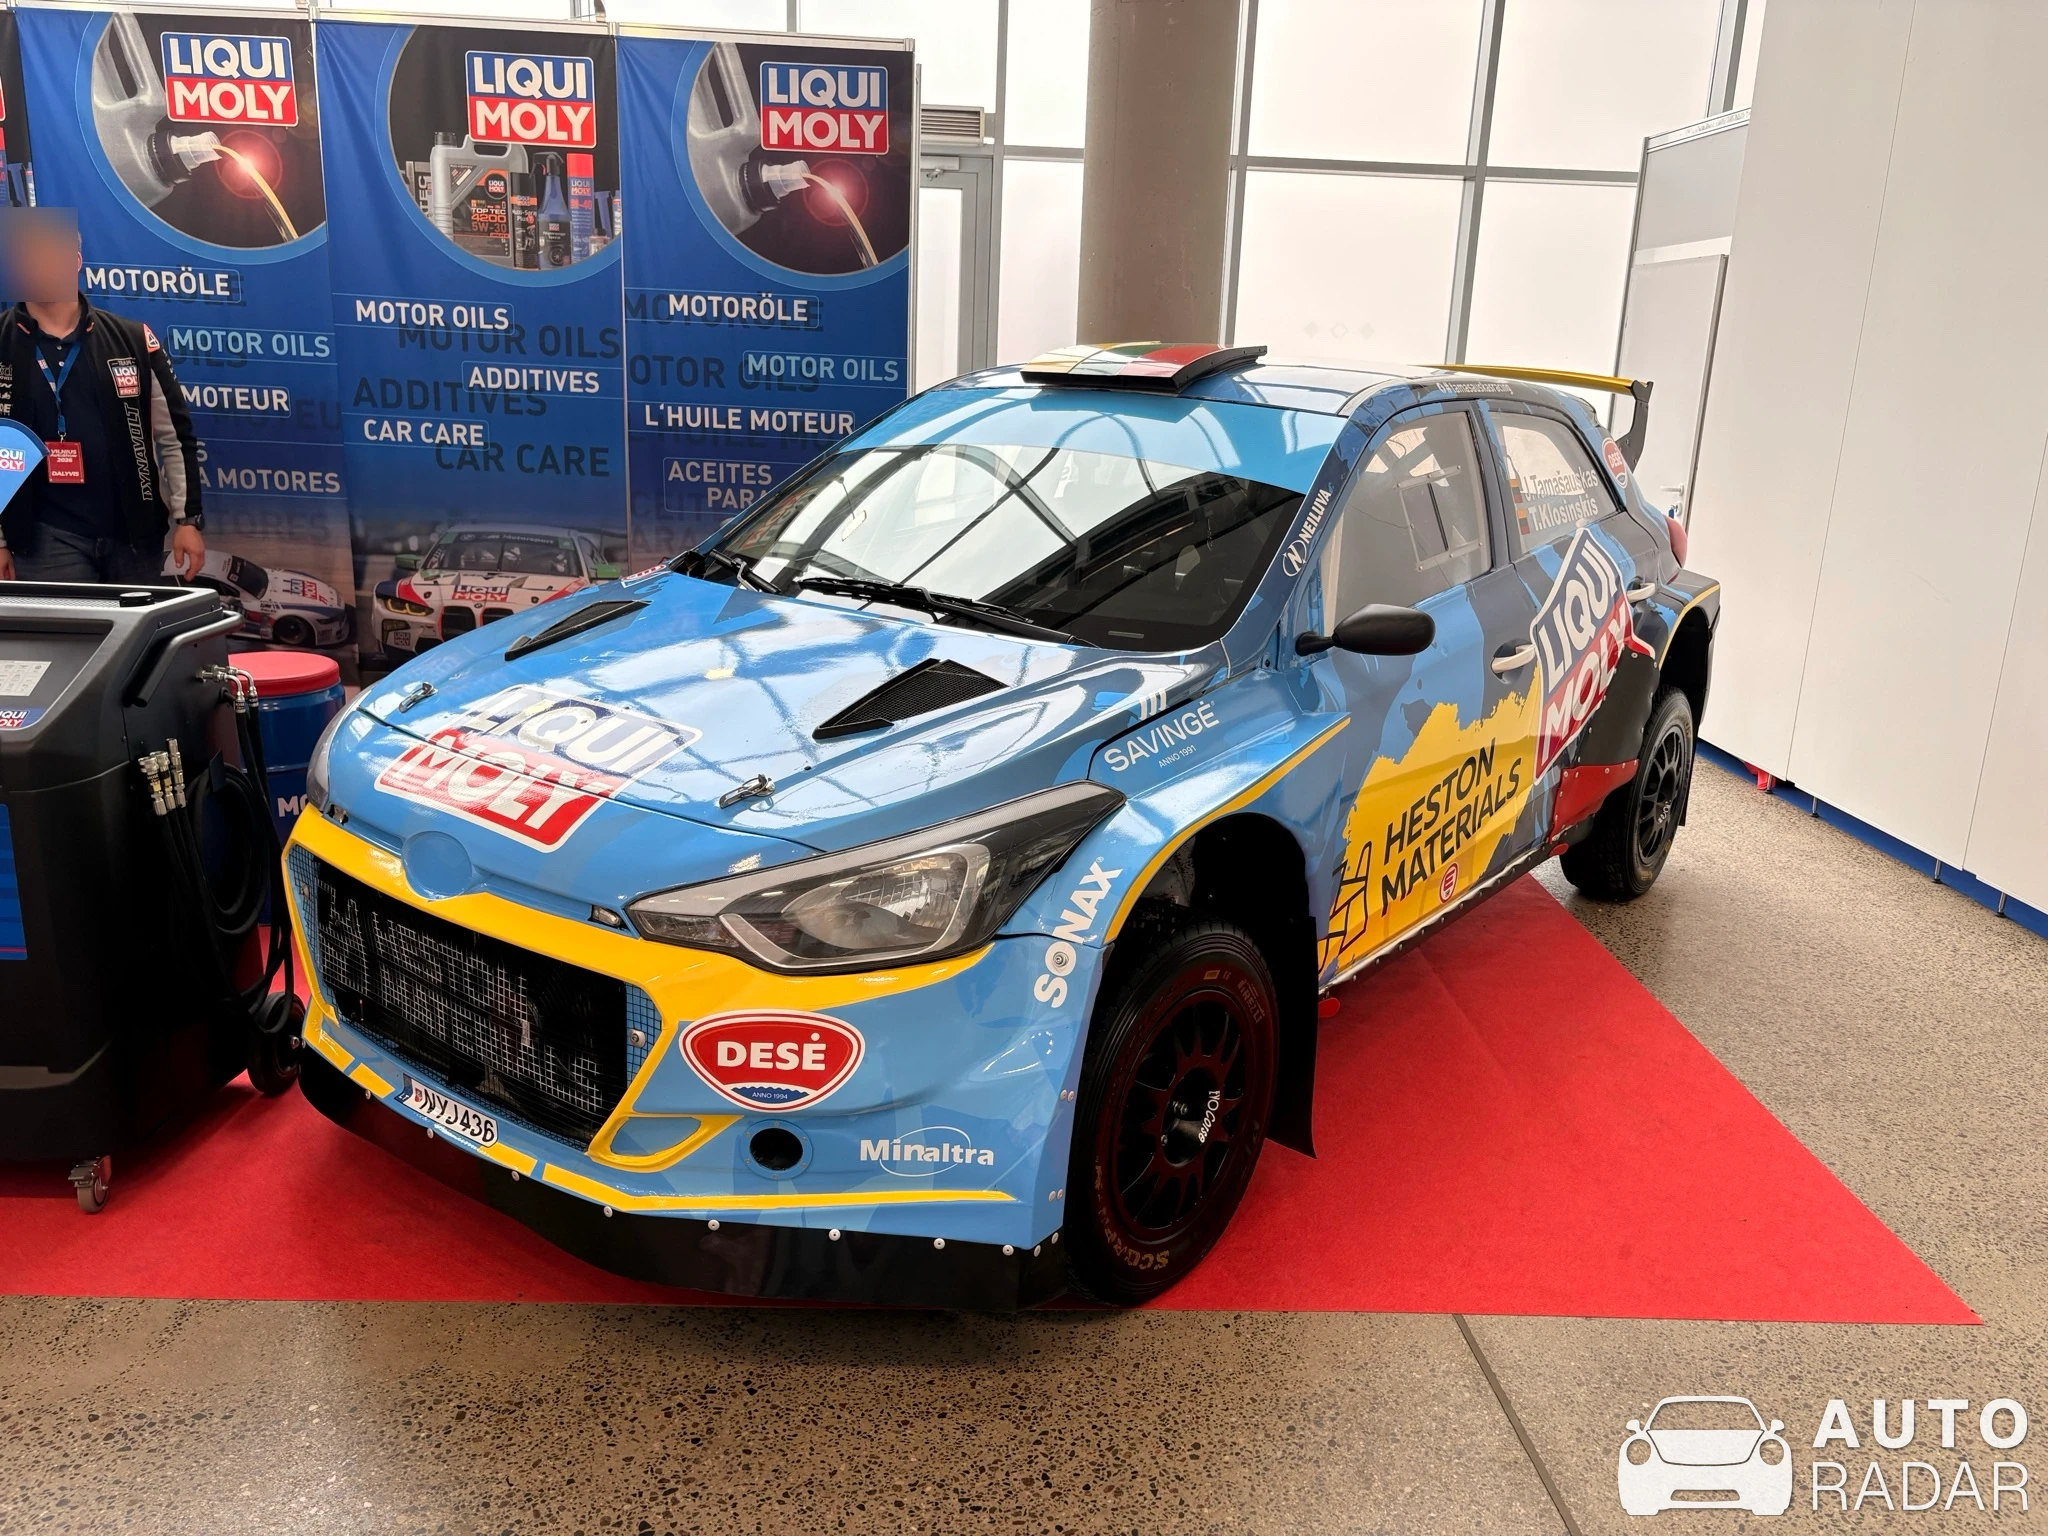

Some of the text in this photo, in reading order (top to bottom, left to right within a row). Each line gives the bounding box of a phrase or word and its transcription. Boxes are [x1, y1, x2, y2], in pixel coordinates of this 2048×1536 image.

[169, 38, 287, 79] LIQUI
[473, 56, 588, 99] LIQUI
[768, 68, 880, 108] LIQUI
[172, 81, 292, 120] MOLY
[475, 100, 592, 141] MOLY
[769, 110, 885, 148] MOLY
[471, 214, 506, 222] 4200
[471, 222, 507, 232] 5W-30
[85, 266, 231, 296] MOTORÖLE
[356, 300, 510, 330] MOTOR OILS
[668, 293, 809, 322] MOTORÖLE
[172, 328, 331, 358] MOTOR OILS
[538, 325, 621, 359] OILS
[113, 367, 138, 378] LIQU
[468, 366, 600, 394] ADDITIVES
[747, 354, 899, 382] MOTOR OILS
[181, 384, 290, 412] MOTEUR
[363, 419, 485, 446] CAR CARE
[750, 409, 855, 435] MOTEUR
[124, 402, 153, 501] DYNAVOLT
[516, 444, 610, 478] CARE
[217, 467, 341, 493] MOTORES
[668, 460, 773, 486] ACEITES
[707, 487, 767, 510] PAR
[1298, 489, 1332, 544] NEILUVA
[453, 592, 508, 602] MOLY
[457, 585, 507, 594] LIQUI
[1538, 539, 1618, 694] LIQUI
[1541, 600, 1627, 767] MOLY
[460, 692, 680, 773] LIQUI
[1104, 700, 1220, 772] SAVINGĖ
[1158, 744, 1197, 768] ANNO 1991
[393, 732, 617, 830] MOLY
[1384, 737, 1496, 866] HESTON
[1381, 758, 1522, 917] MATERIALS
[1034, 861, 1123, 1009] SONAX
[717, 1032, 827, 1071] DESĖ
[752, 1091, 788, 1101] ANNO 1994
[859, 1139, 995, 1166] Minaltra
